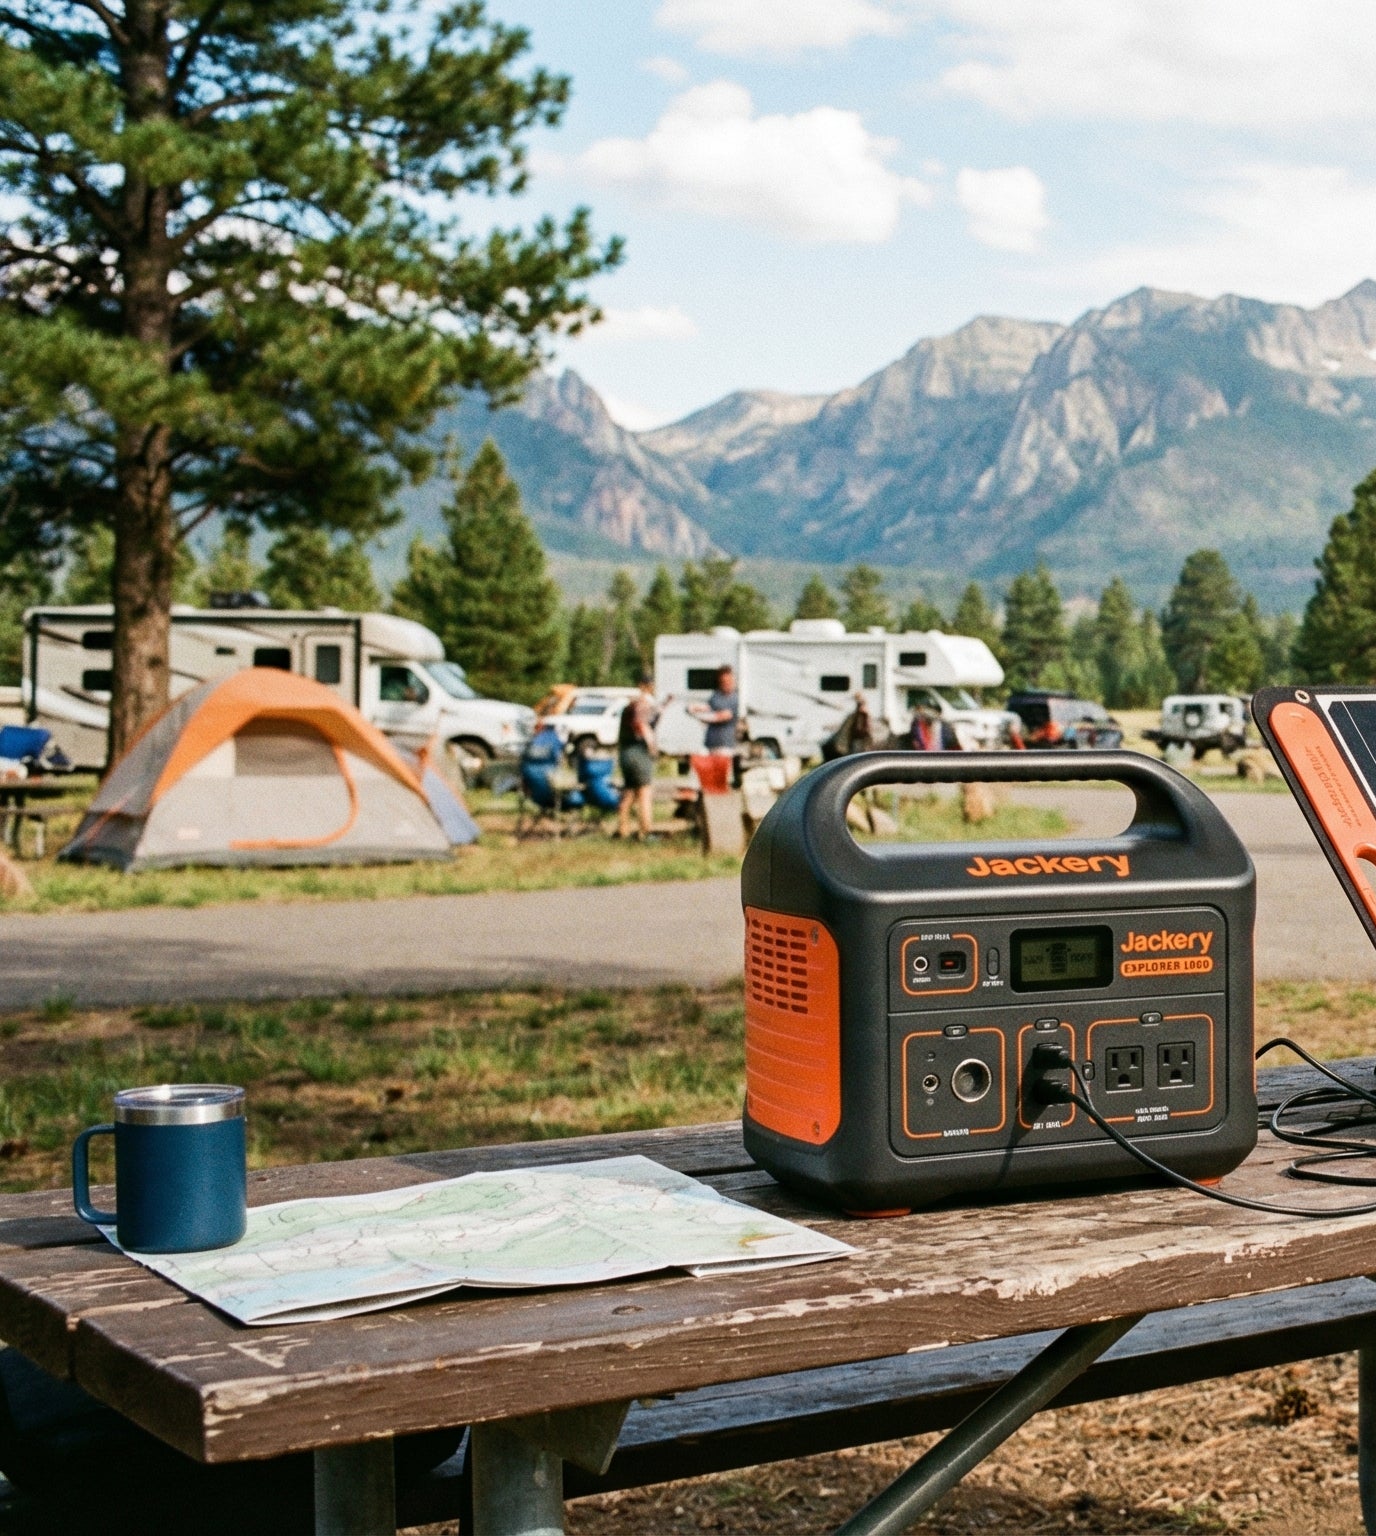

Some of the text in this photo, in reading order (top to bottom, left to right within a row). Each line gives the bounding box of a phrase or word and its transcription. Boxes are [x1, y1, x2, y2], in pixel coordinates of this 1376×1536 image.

[966, 854, 1130, 878] Jackery
[1120, 929, 1213, 955] Jackery
[1123, 961, 1181, 974] EXPLORER
